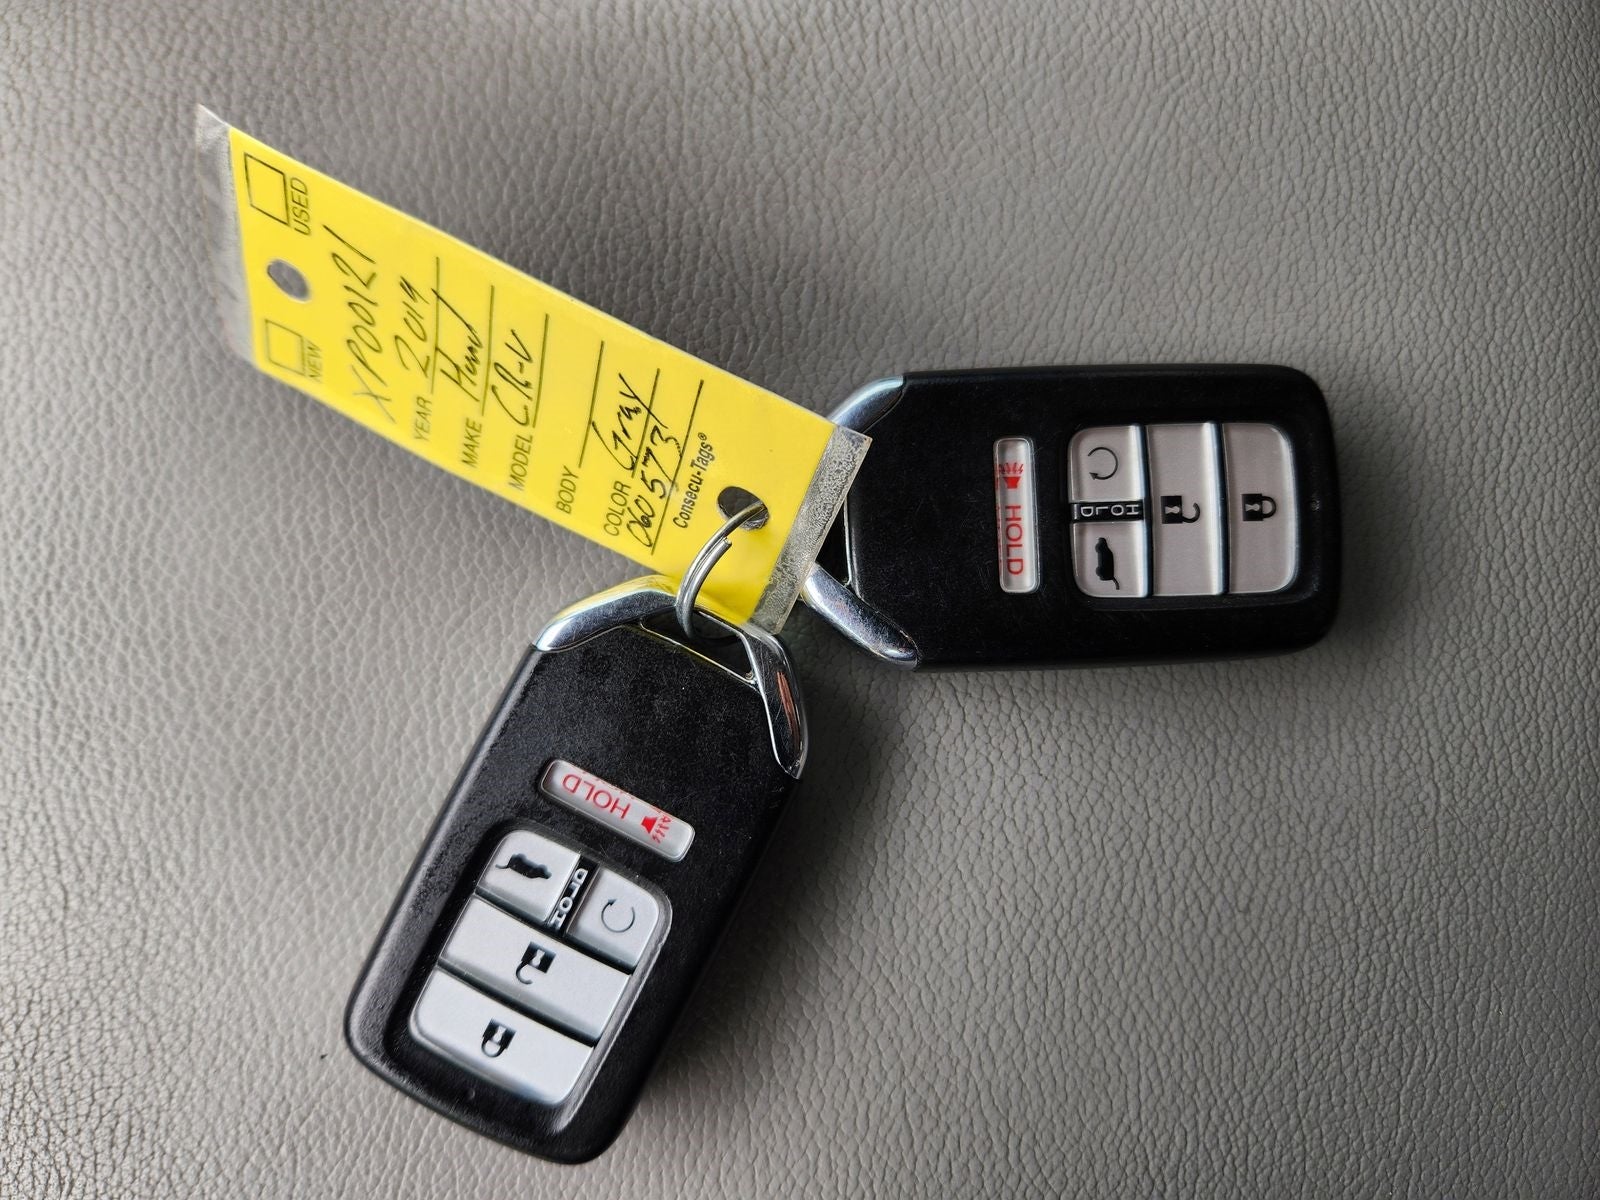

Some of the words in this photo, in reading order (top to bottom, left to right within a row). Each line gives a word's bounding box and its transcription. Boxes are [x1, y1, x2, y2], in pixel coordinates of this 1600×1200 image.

[290, 176, 311, 236] USED
[307, 343, 322, 382] NEW
[491, 329, 533, 427] CR-V
[414, 395, 433, 442] YEAR
[462, 417, 483, 468] MAKE
[591, 373, 669, 472] Gray
[508, 433, 534, 491] MODEL
[556, 465, 580, 515] BODY
[603, 480, 631, 537] COLOR
[1005, 504, 1024, 576] HOLD
[562, 773, 631, 820] HOLD
